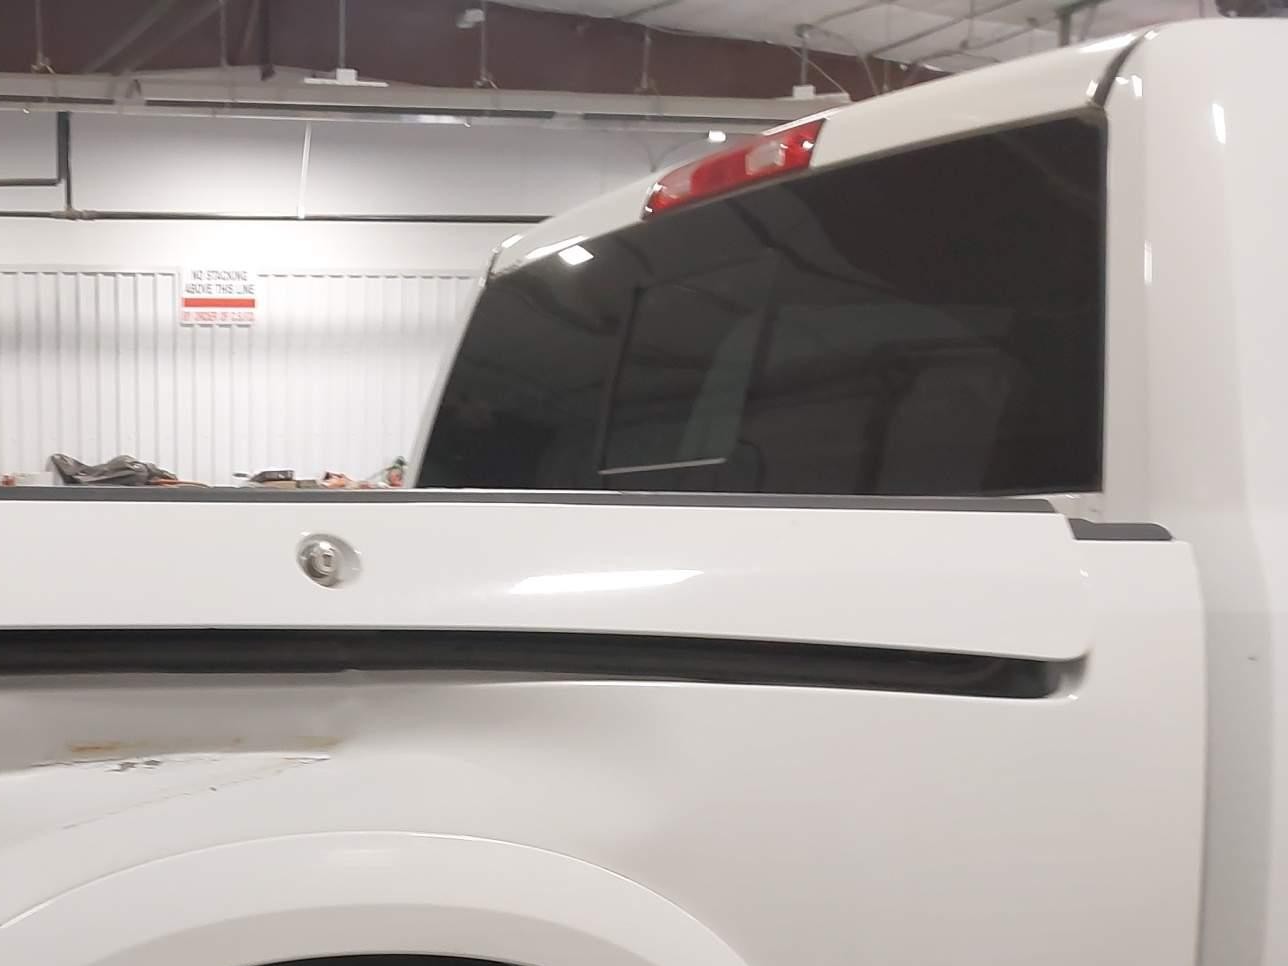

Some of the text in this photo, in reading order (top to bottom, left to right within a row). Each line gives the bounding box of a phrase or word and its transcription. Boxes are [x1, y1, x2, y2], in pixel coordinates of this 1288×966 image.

[192, 270, 248, 281] NO STACKING
[185, 284, 255, 295] ABOVE THIS LINE
